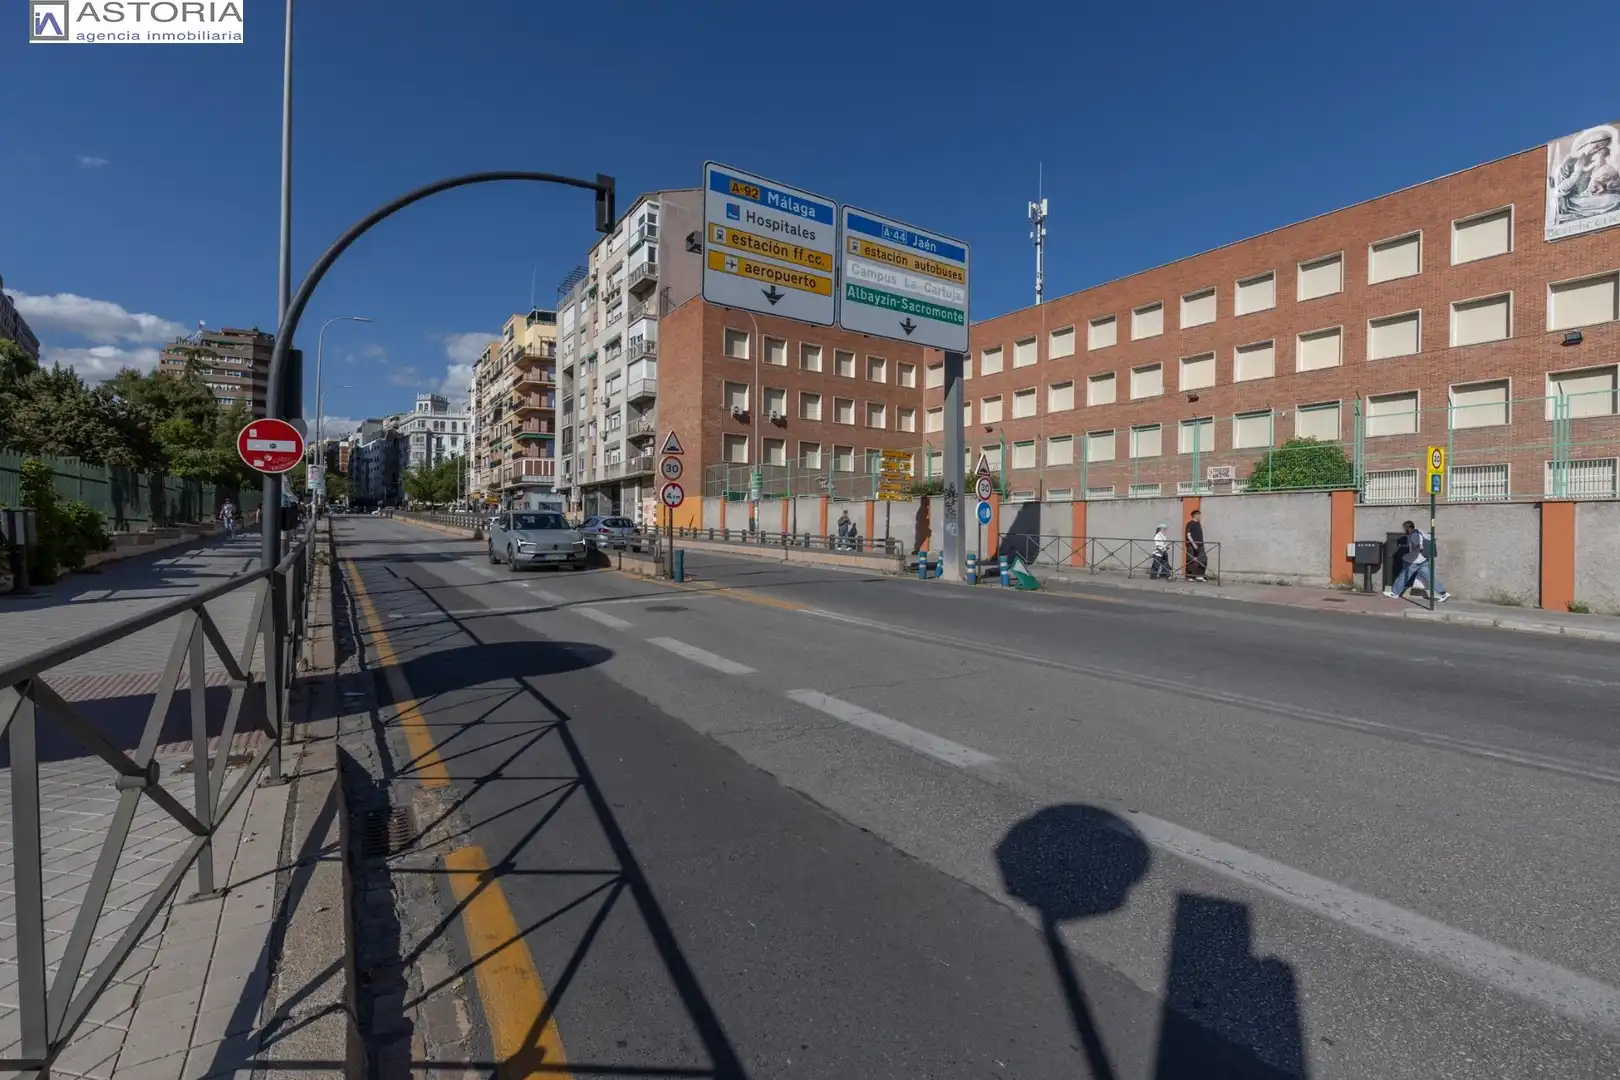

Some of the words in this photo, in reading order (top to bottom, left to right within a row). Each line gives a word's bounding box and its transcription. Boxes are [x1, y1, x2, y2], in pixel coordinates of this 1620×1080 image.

[731, 183, 759, 199] A-92
[767, 191, 816, 218] Málaga
[746, 209, 816, 241] Hospitales
[731, 233, 788, 257] estación
[883, 227, 907, 243] A-44
[912, 235, 937, 252] Jaén
[745, 262, 816, 289] aeropuerto
[864, 246, 908, 266] estación
[914, 260, 963, 281] autobuses
[851, 263, 897, 285] Campus
[904, 276, 917, 290] La
[924, 282, 963, 302] Cartuja
[665, 463, 679, 473] 30
[981, 483, 990, 493] 30
